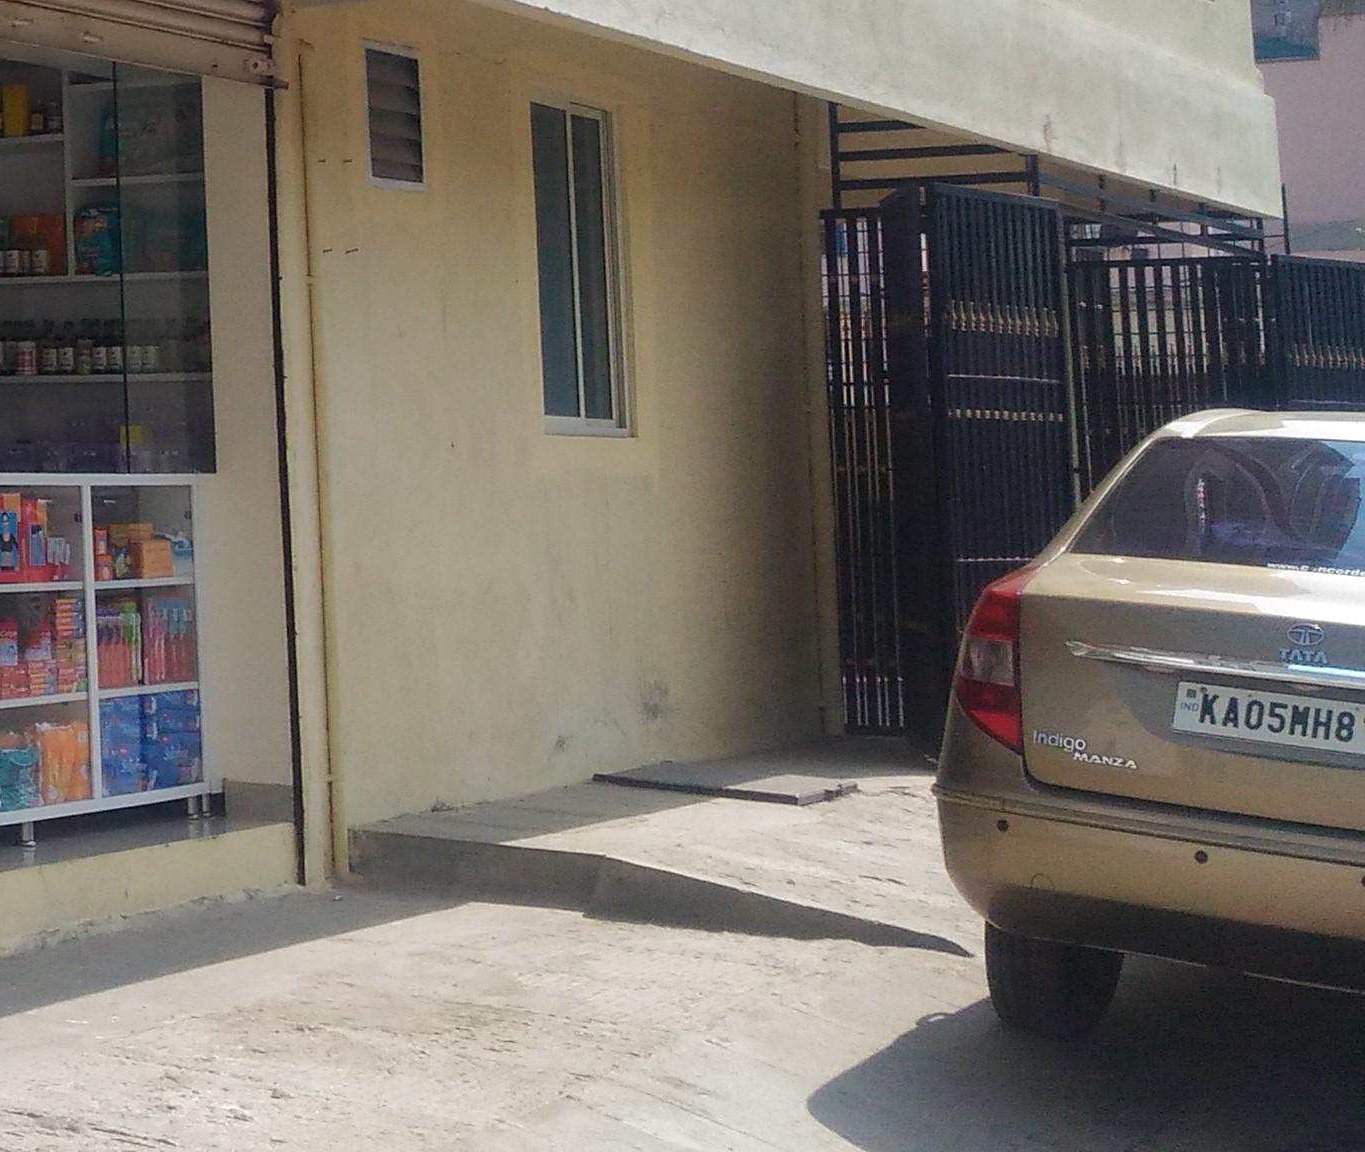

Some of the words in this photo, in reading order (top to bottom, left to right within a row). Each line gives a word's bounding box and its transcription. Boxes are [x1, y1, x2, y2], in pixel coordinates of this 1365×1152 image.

[1279, 648, 1328, 665] TATA
[1180, 702, 1199, 713] IND
[1198, 693, 1365, 743] KA05MH8
[1033, 729, 1086, 752] Indigo
[1073, 751, 1138, 770] MANZA
